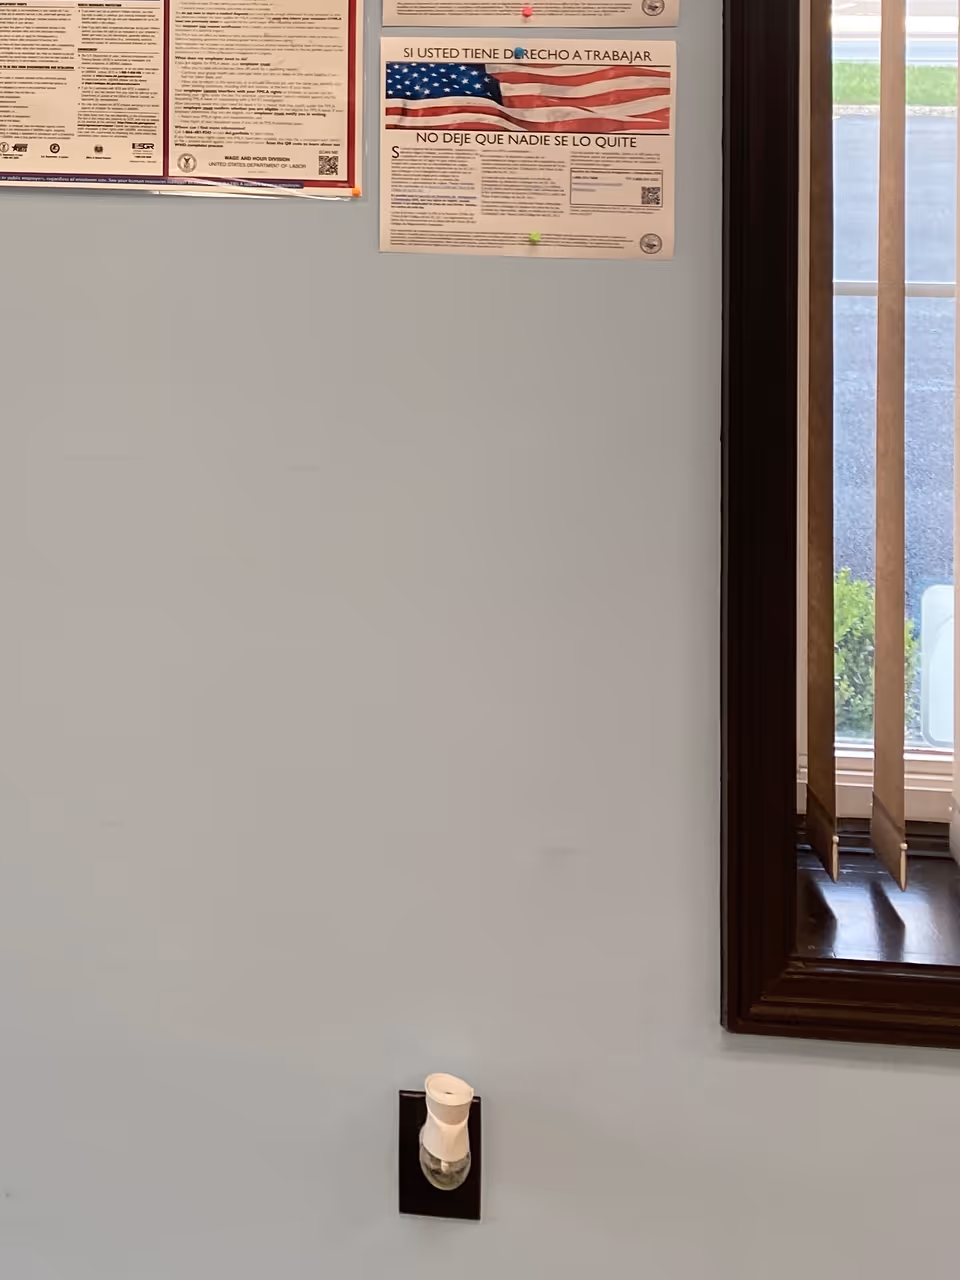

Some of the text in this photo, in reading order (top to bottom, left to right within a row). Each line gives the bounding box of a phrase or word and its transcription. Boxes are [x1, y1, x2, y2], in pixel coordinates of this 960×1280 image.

[404, 48, 413, 57] SI
[418, 48, 460, 58] USTED
[462, 48, 500, 59] TIENE
[572, 50, 582, 60] A
[584, 50, 652, 64] TRABAJAR
[416, 133, 637, 149] NO DEJE QUE NADIE SE LO QUITE
